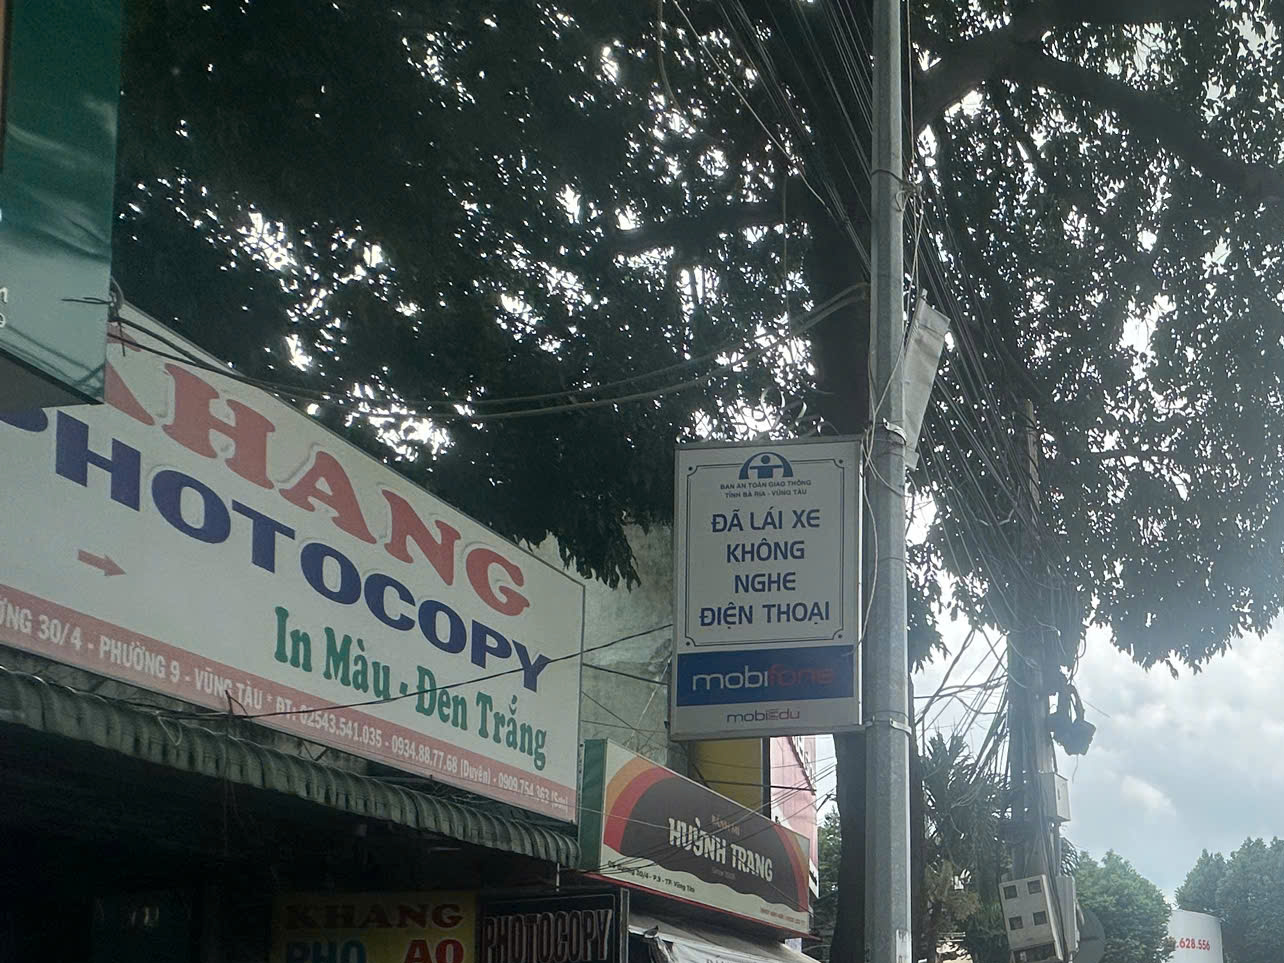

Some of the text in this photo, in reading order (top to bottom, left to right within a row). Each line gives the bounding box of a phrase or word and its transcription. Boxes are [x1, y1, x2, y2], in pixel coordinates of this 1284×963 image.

[748, 481, 767, 489] TOÀN
[787, 479, 812, 487] THÔNG
[771, 489, 791, 497] VŨNG
[793, 488, 807, 496] TÀU
[711, 506, 820, 533] ĐÃ LÁI XE
[726, 537, 805, 564] KHÔNG
[735, 572, 796, 594] NGHE
[699, 601, 830, 630] ĐIỆN THOẠI
[38, 614, 83, 653] 30/4
[100, 634, 166, 680] PHƯỜNG
[170, 660, 181, 684] 9
[195, 666, 233, 701] VŨNG
[237, 676, 263, 710] TÀU
[274, 606, 312, 673] In
[325, 627, 391, 701] Màu
[415, 664, 469, 732] Đen
[476, 692, 549, 772] Trắng
[692, 664, 834, 691] mobifone
[726, 707, 800, 724] mobiEdu
[668, 817, 774, 882] HUỲNH TRANG
[284, 903, 465, 930] KHANG
